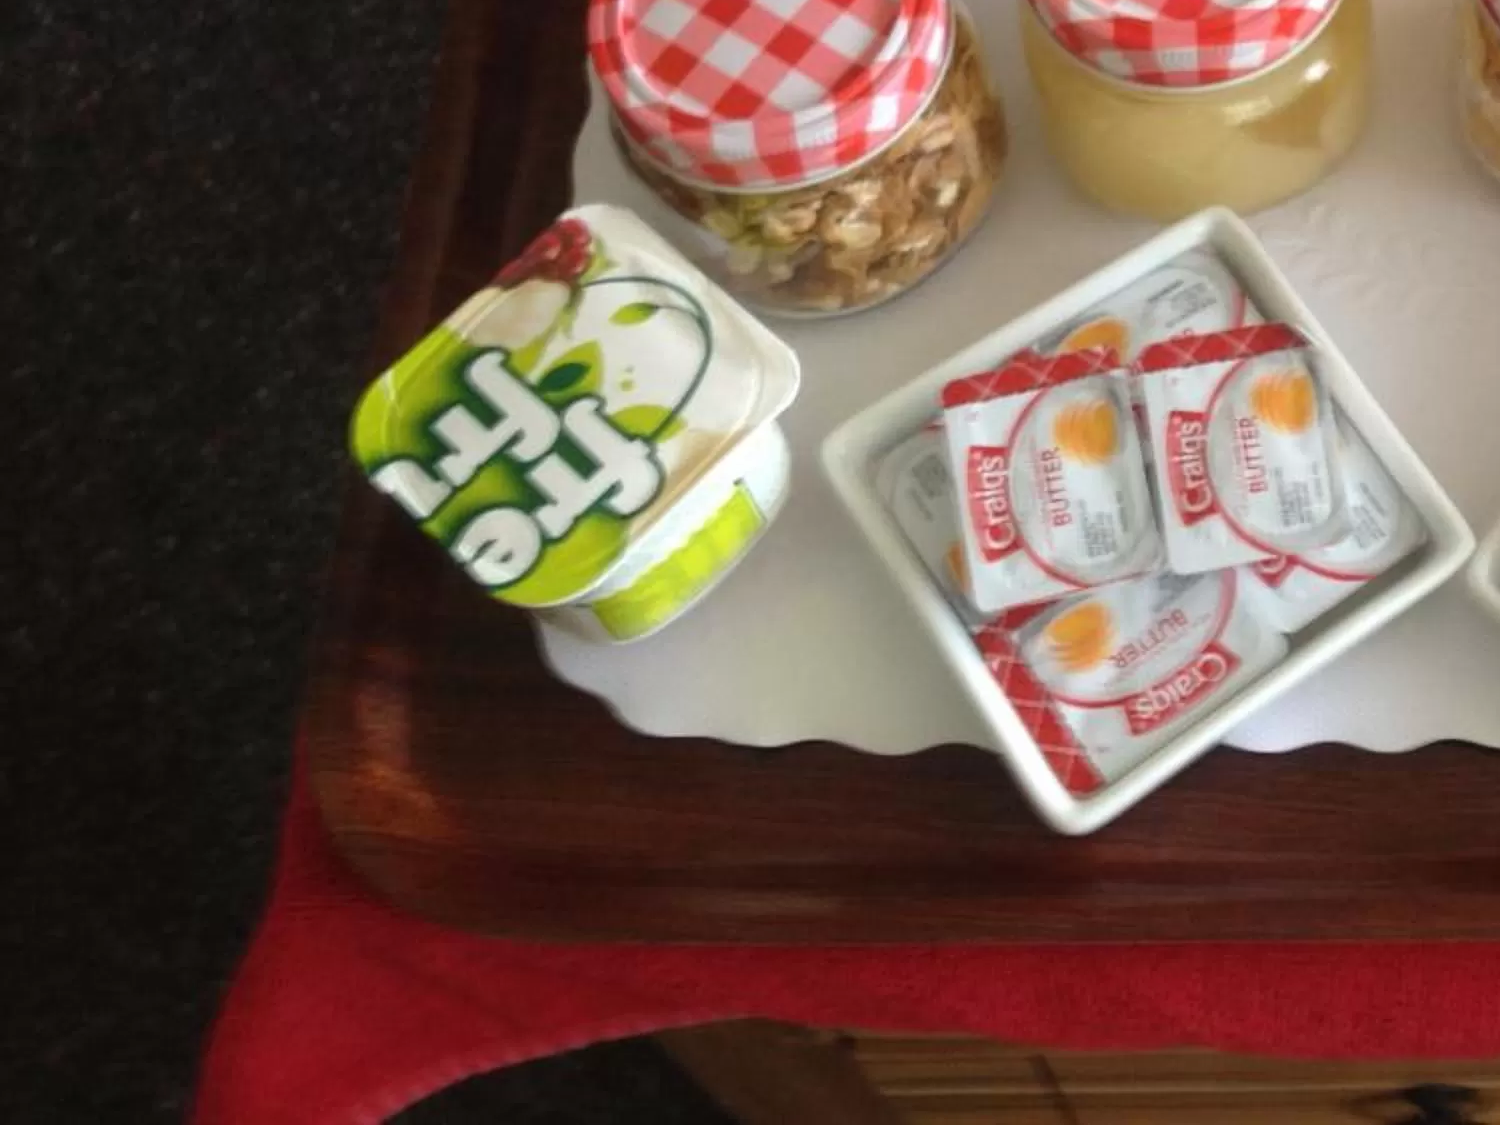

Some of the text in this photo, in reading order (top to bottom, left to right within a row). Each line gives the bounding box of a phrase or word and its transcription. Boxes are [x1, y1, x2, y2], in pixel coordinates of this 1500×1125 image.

[450, 396, 662, 587] fre
[1040, 446, 1073, 528] BUTTER
[1239, 415, 1268, 494] BUTTER
[1109, 608, 1188, 669] BUTTER
